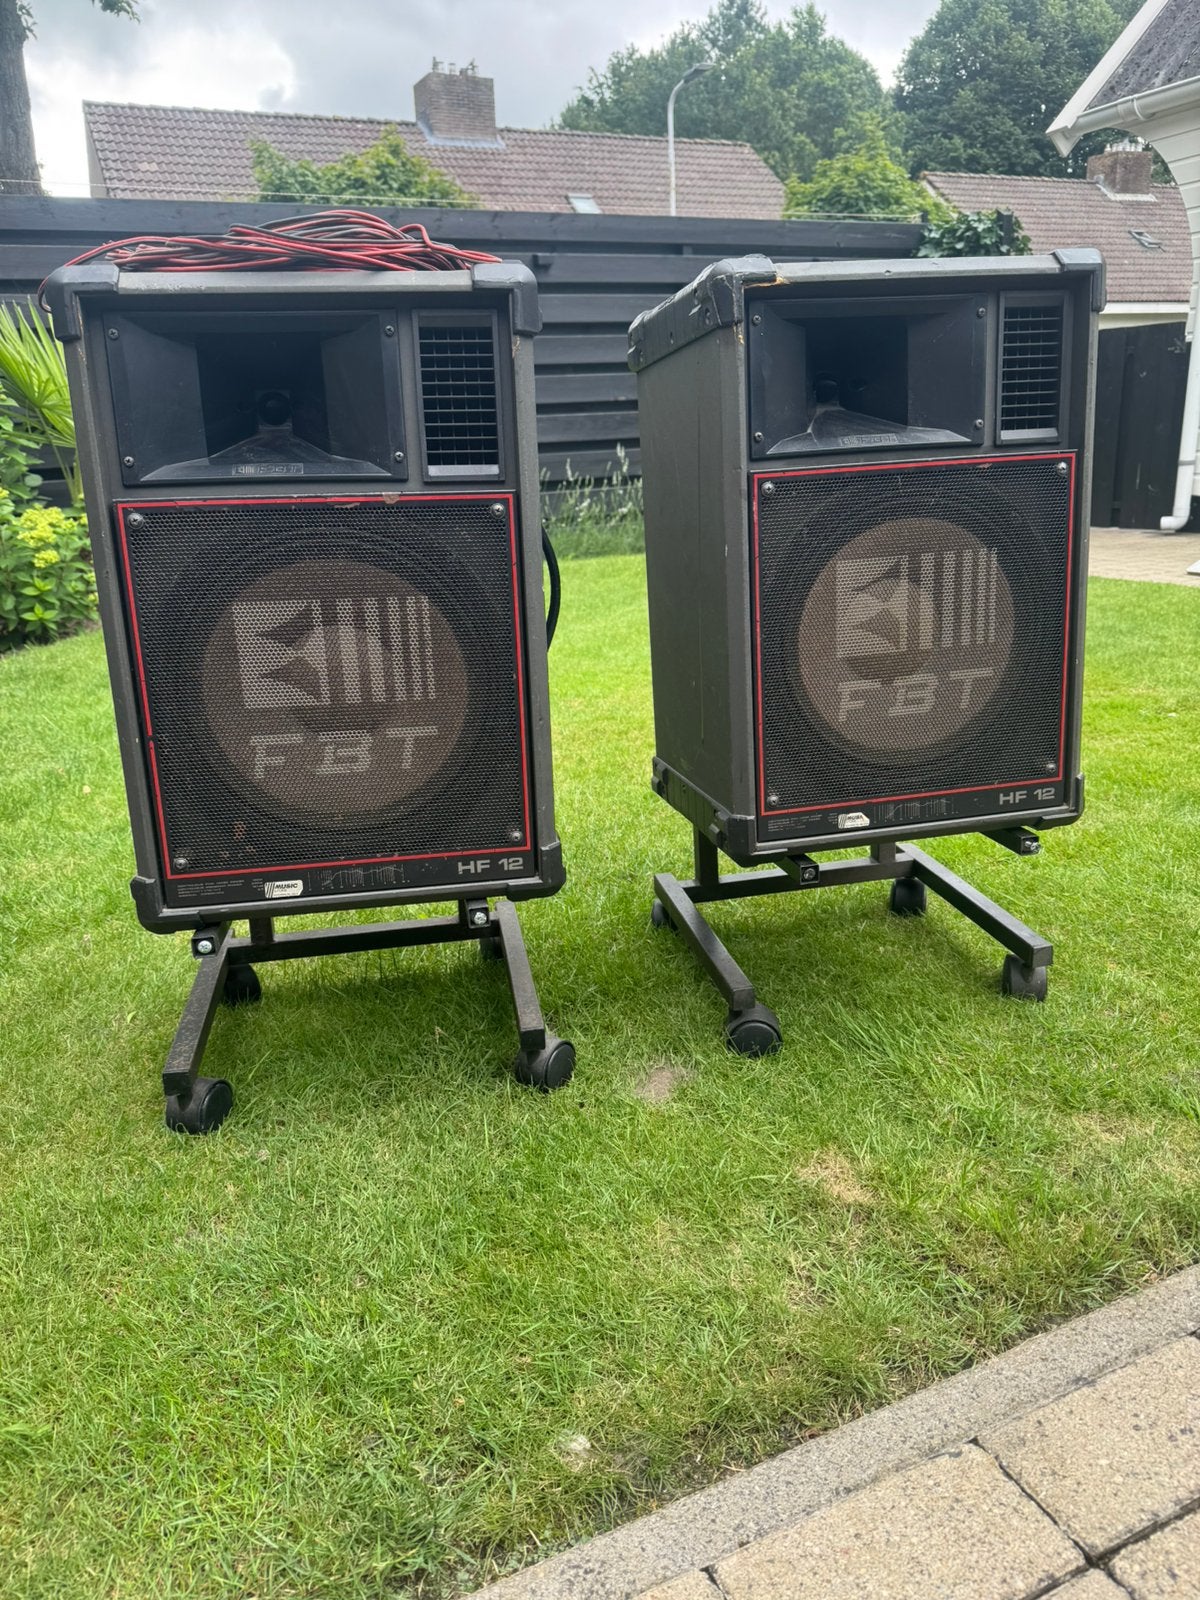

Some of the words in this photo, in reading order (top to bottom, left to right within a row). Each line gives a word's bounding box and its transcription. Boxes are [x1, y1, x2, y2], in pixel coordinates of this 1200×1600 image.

[838, 667, 994, 722] FBT
[249, 726, 438, 779] FBT
[999, 790, 1028, 805] HF
[1033, 787, 1056, 801] 12
[457, 859, 491, 874] HF
[498, 857, 524, 871] 12
